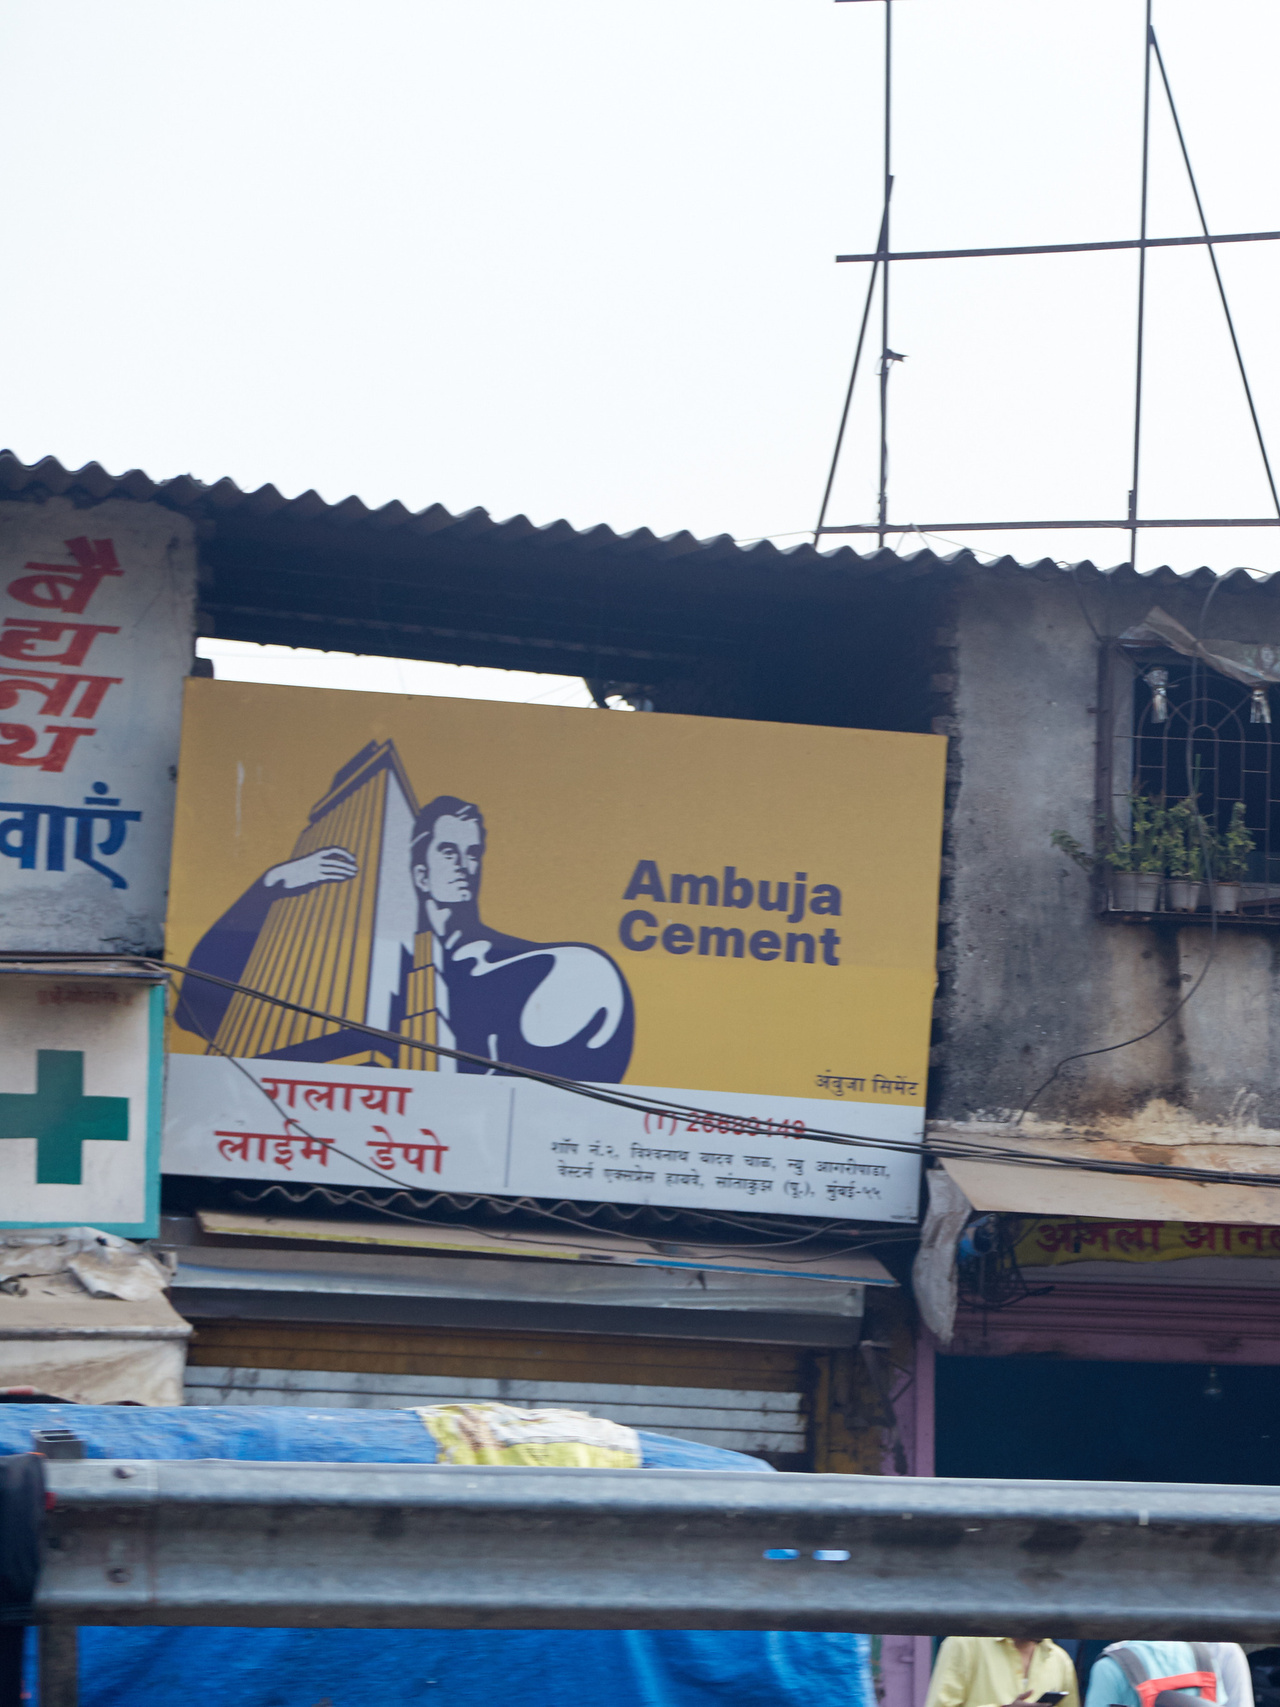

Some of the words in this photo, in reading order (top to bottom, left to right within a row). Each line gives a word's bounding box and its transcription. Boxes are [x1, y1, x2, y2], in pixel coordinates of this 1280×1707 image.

[622, 859, 842, 924] Ambuja
[618, 909, 841, 966] Cement
[213, 1119, 335, 1171] लाईम
[366, 1125, 449, 1174] डेपो
